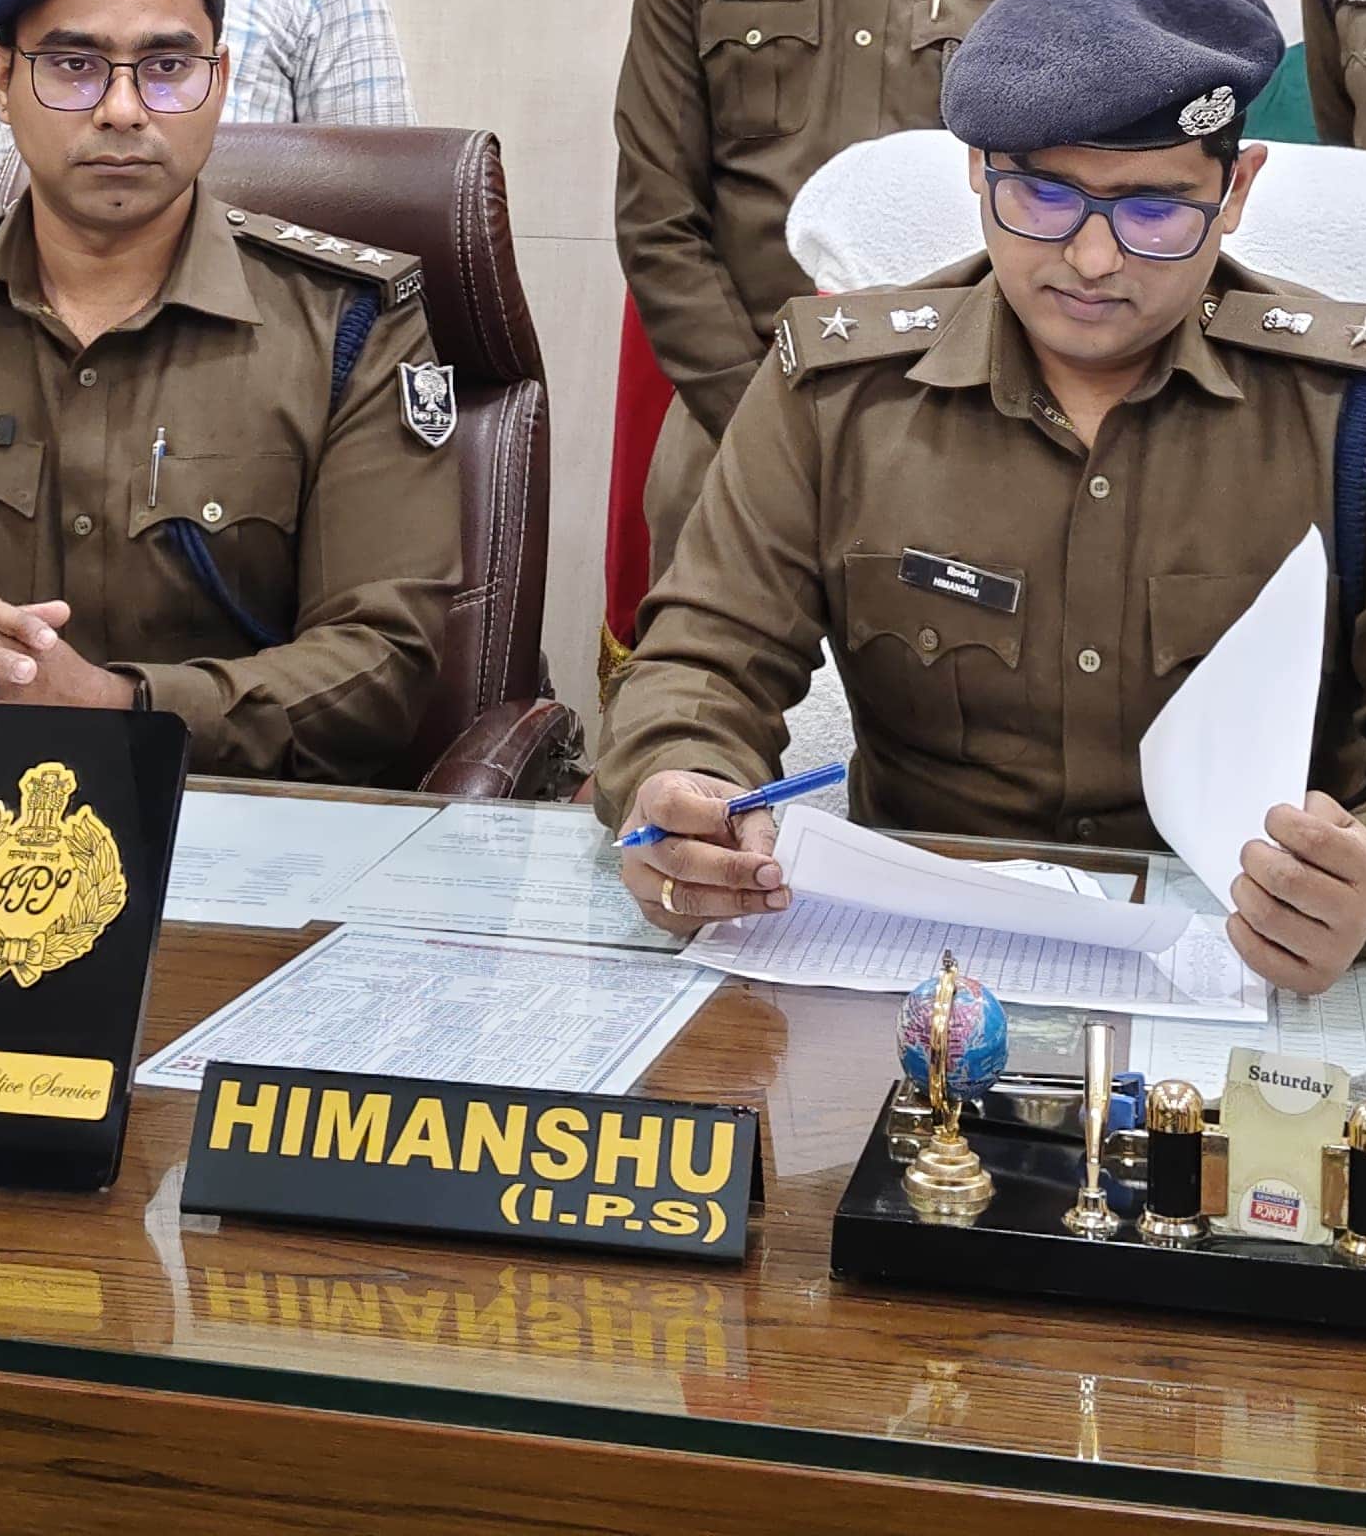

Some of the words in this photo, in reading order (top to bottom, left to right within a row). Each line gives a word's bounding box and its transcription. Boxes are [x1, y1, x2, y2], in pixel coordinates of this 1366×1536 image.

[932, 576, 980, 598] HIMANSHU
[29, 1072, 102, 1101] Service
[1248, 1065, 1334, 1098] Saturday
[208, 1080, 737, 1194] HIMANSHU
[500, 1183, 728, 1244] (I.P.S)
